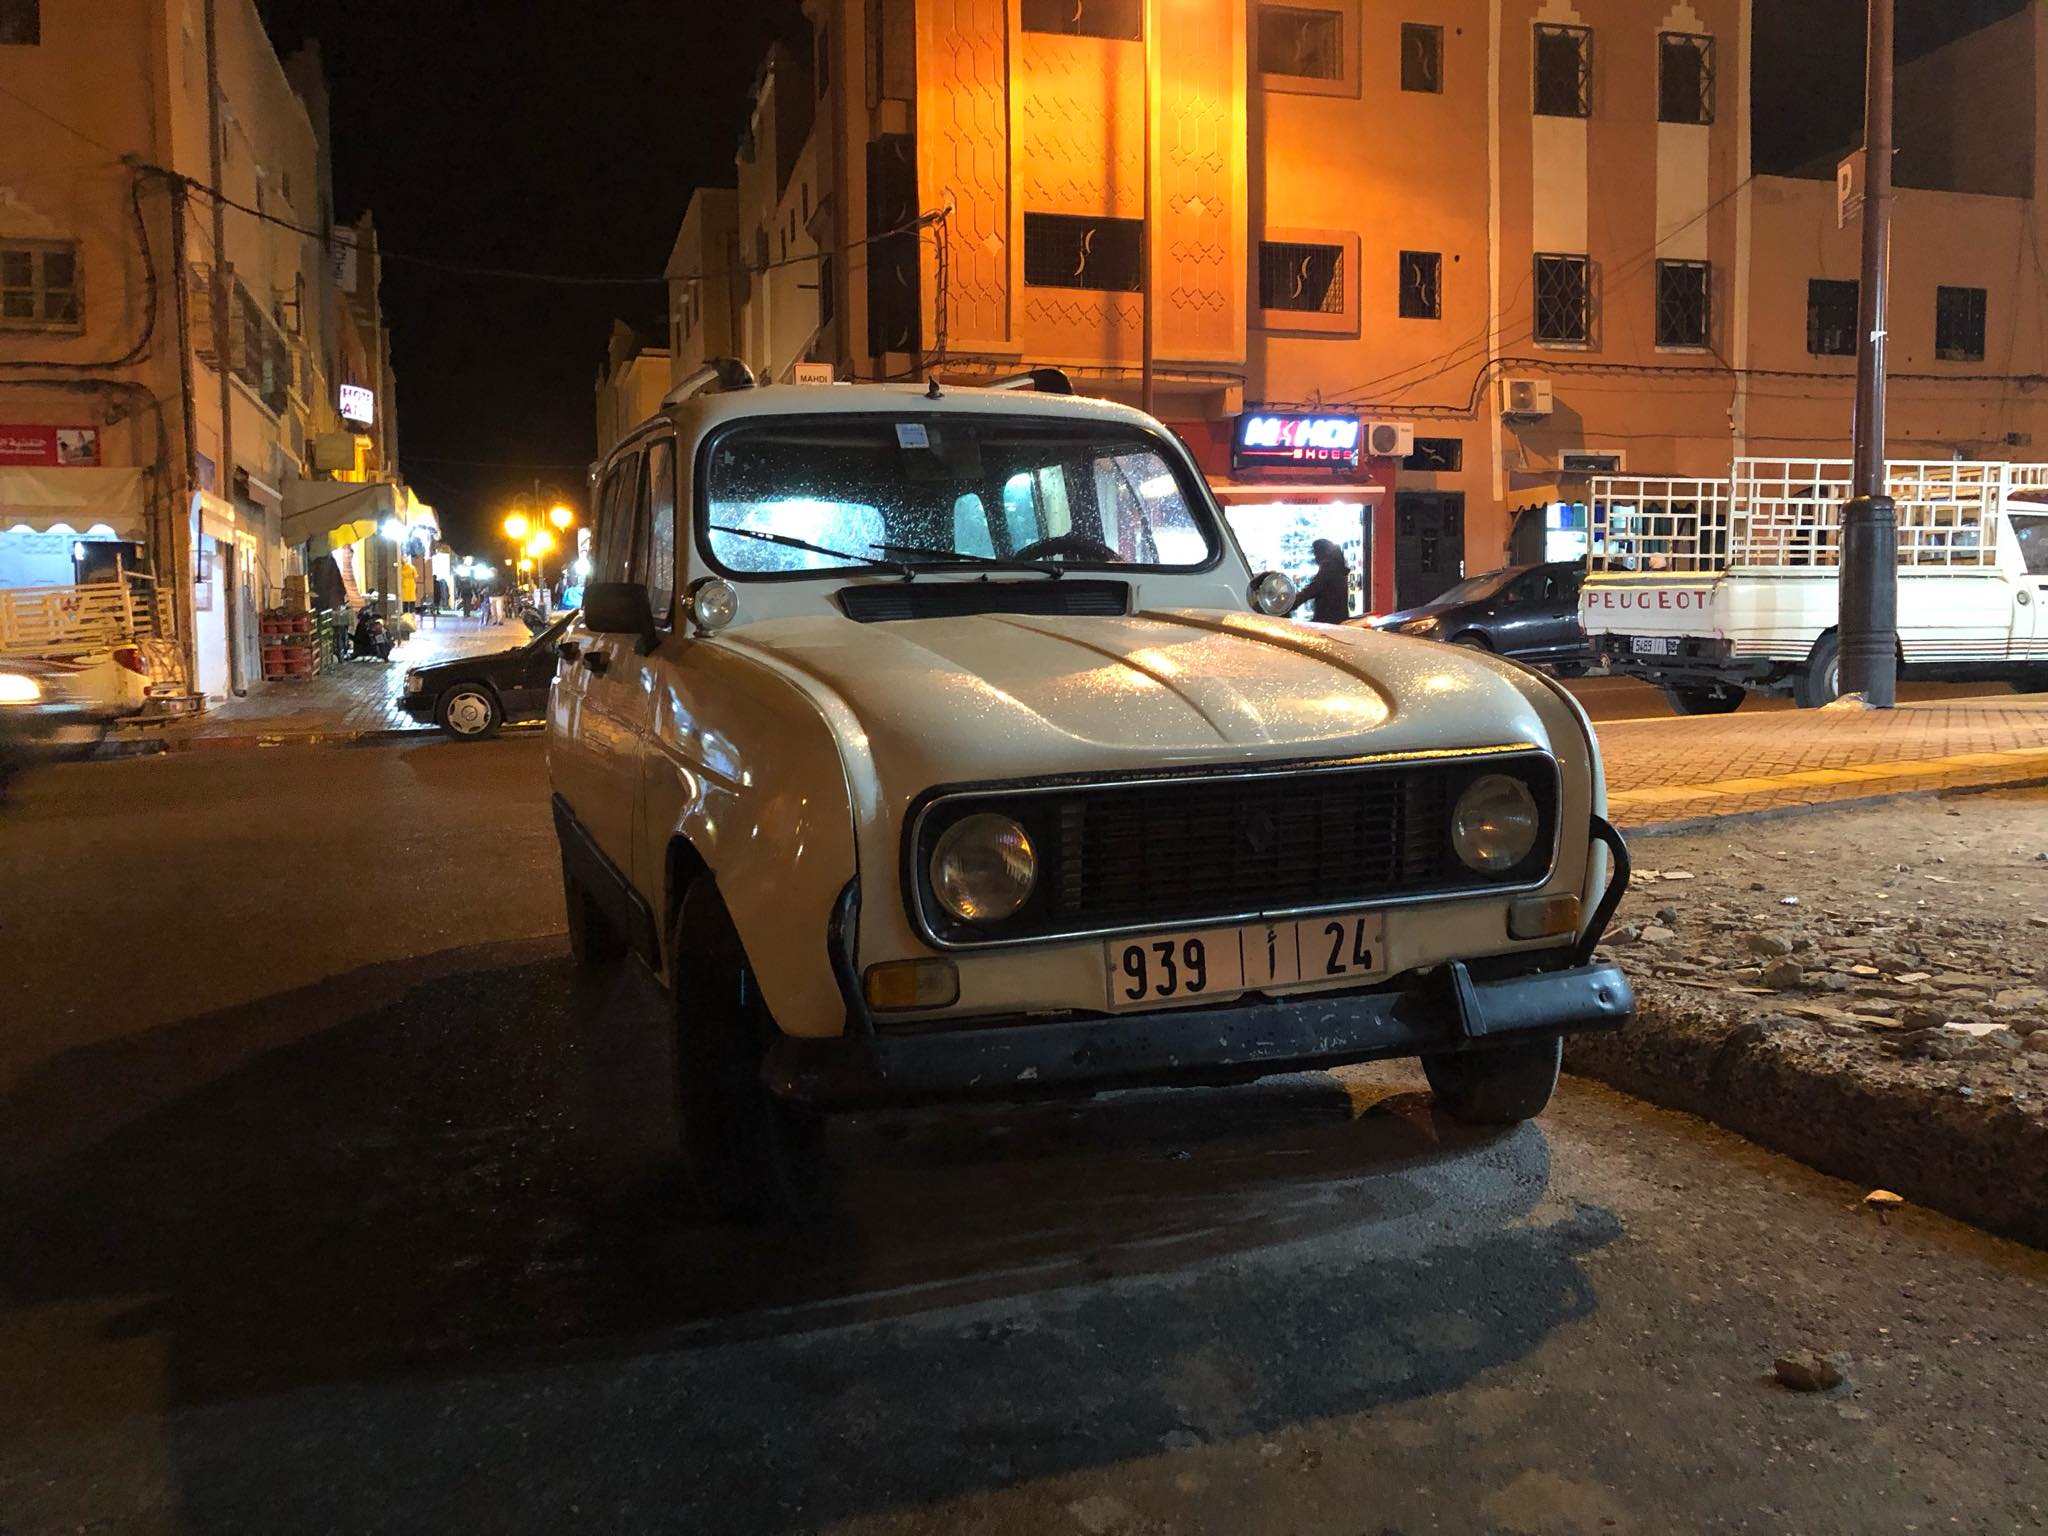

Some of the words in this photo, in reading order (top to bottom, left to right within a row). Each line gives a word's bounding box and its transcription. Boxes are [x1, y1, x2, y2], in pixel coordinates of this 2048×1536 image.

[1838, 163, 1852, 229] P
[800, 375, 828, 383] MAHDI
[1293, 448, 1353, 459] SHOES
[1588, 591, 1706, 609] PEUGEOT
[1122, 938, 1207, 1000] 939
[1324, 918, 1372, 975] 24
